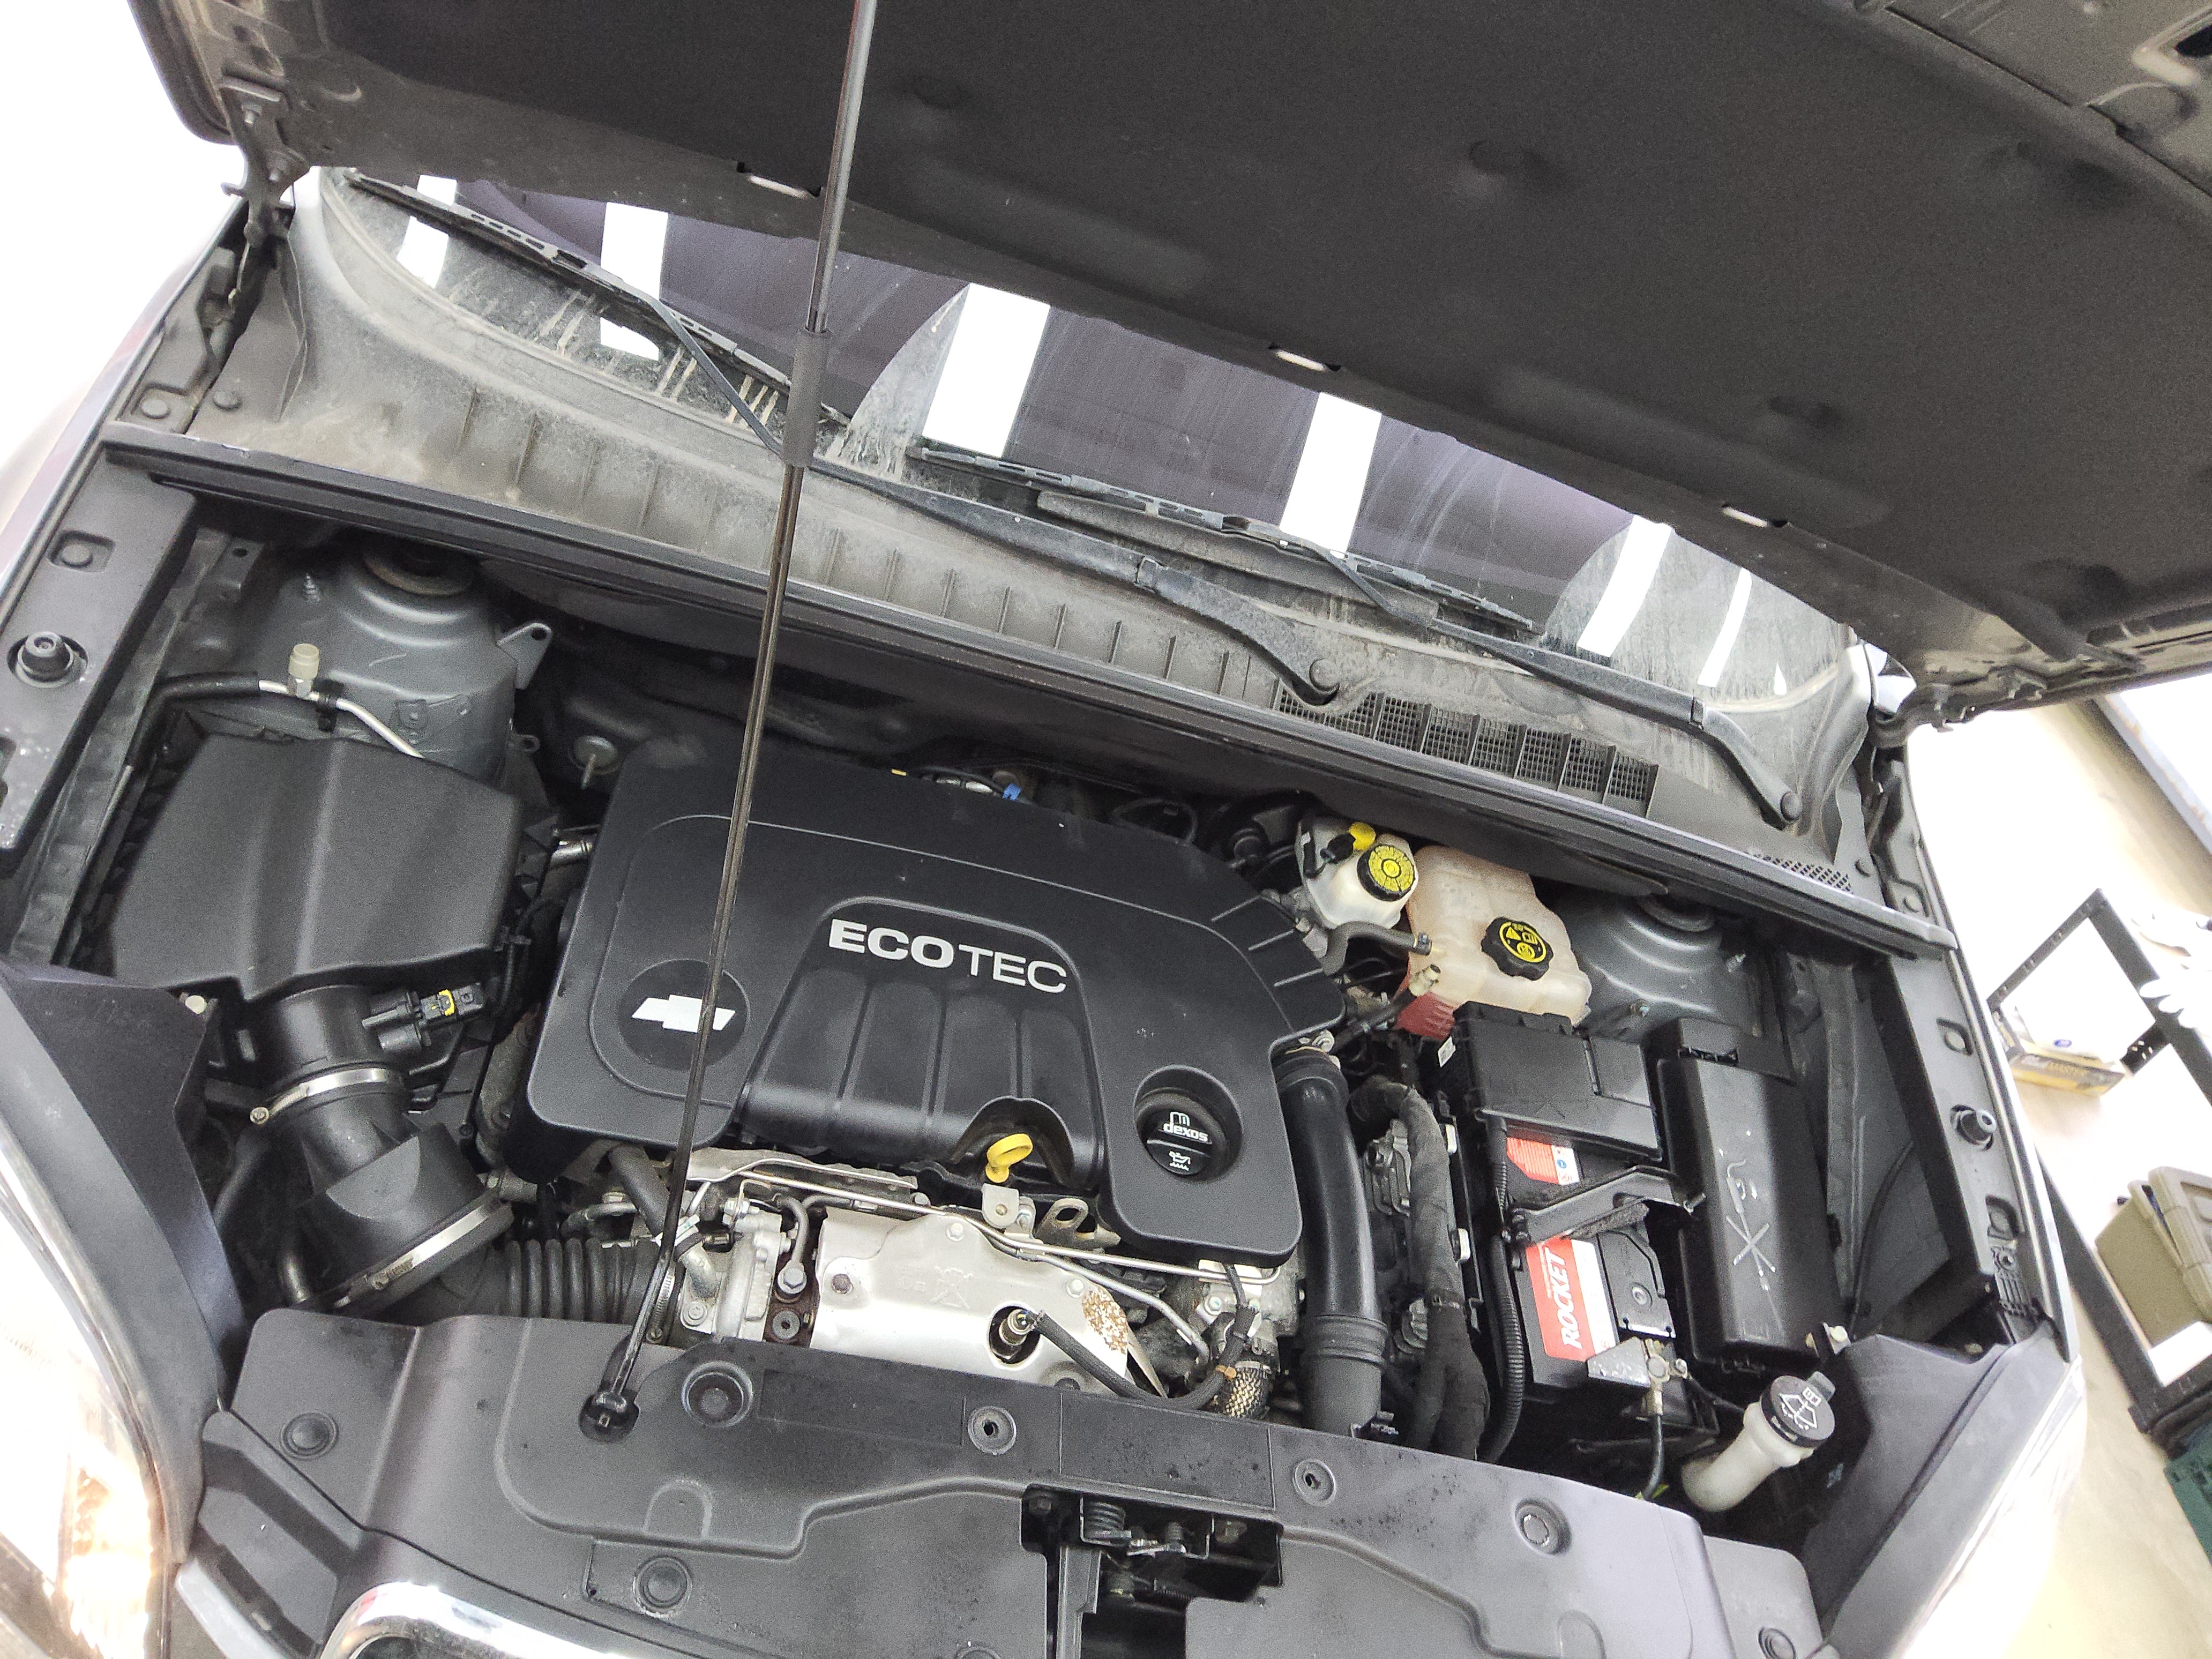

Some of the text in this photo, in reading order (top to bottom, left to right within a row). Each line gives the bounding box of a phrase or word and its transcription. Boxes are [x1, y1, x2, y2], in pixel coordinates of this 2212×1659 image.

[828, 918, 1066, 993] ECOTEC
[1163, 1119, 1208, 1142] dexos
[1544, 1246, 1582, 1350] ROCKET
